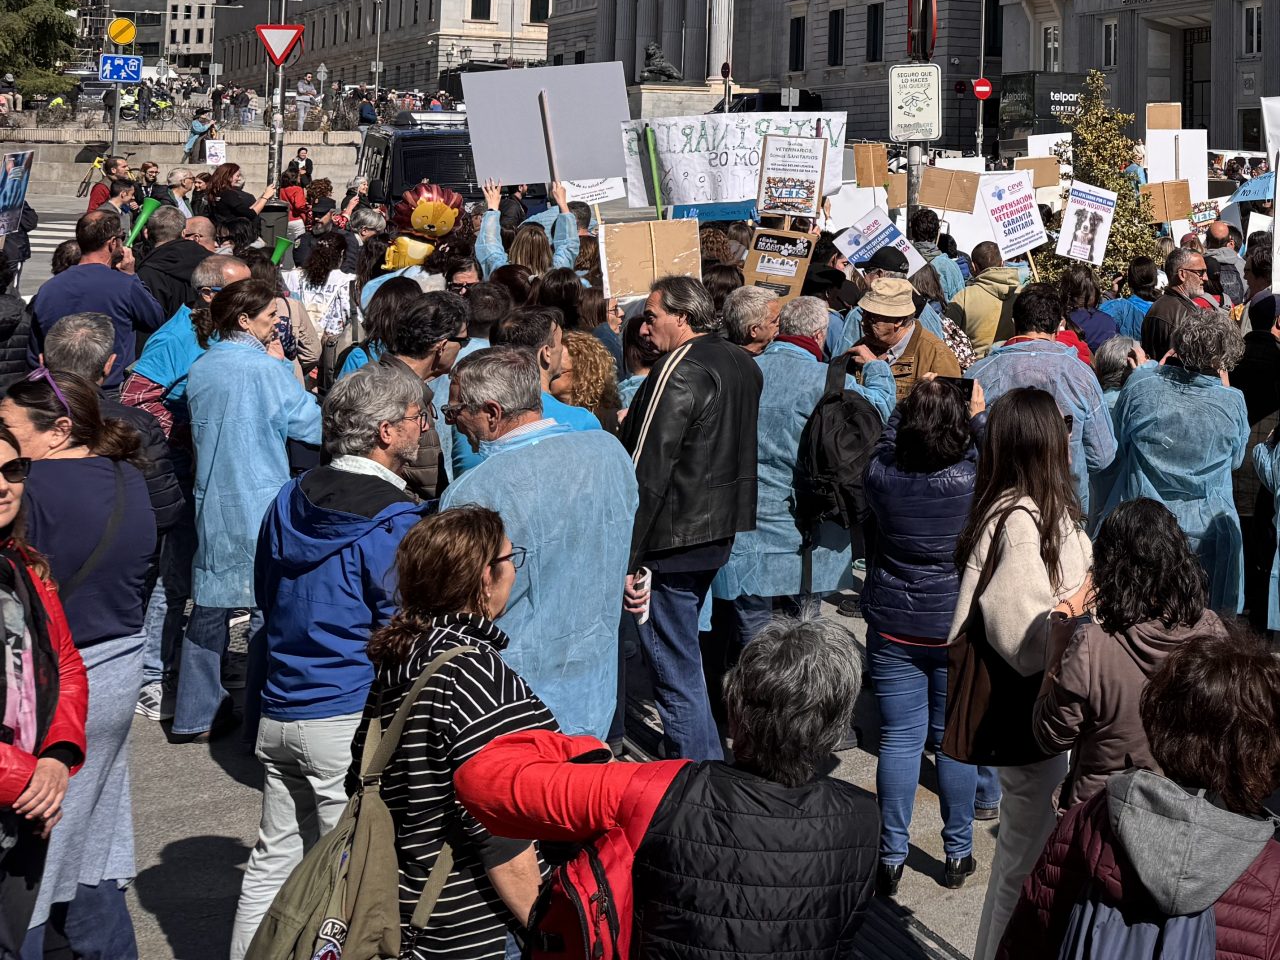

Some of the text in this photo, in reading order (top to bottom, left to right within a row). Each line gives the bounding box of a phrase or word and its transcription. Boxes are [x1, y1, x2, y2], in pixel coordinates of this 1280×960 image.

[771, 187, 809, 198] VETS
[1007, 180, 1023, 192] ceve
[990, 193, 1033, 216] DISPENSACIÓN
[994, 202, 1034, 223] VETERINARIA
[1192, 209, 1217, 222] VETS
[862, 219, 880, 235] ceve
[1003, 219, 1034, 237] SANITARIA
